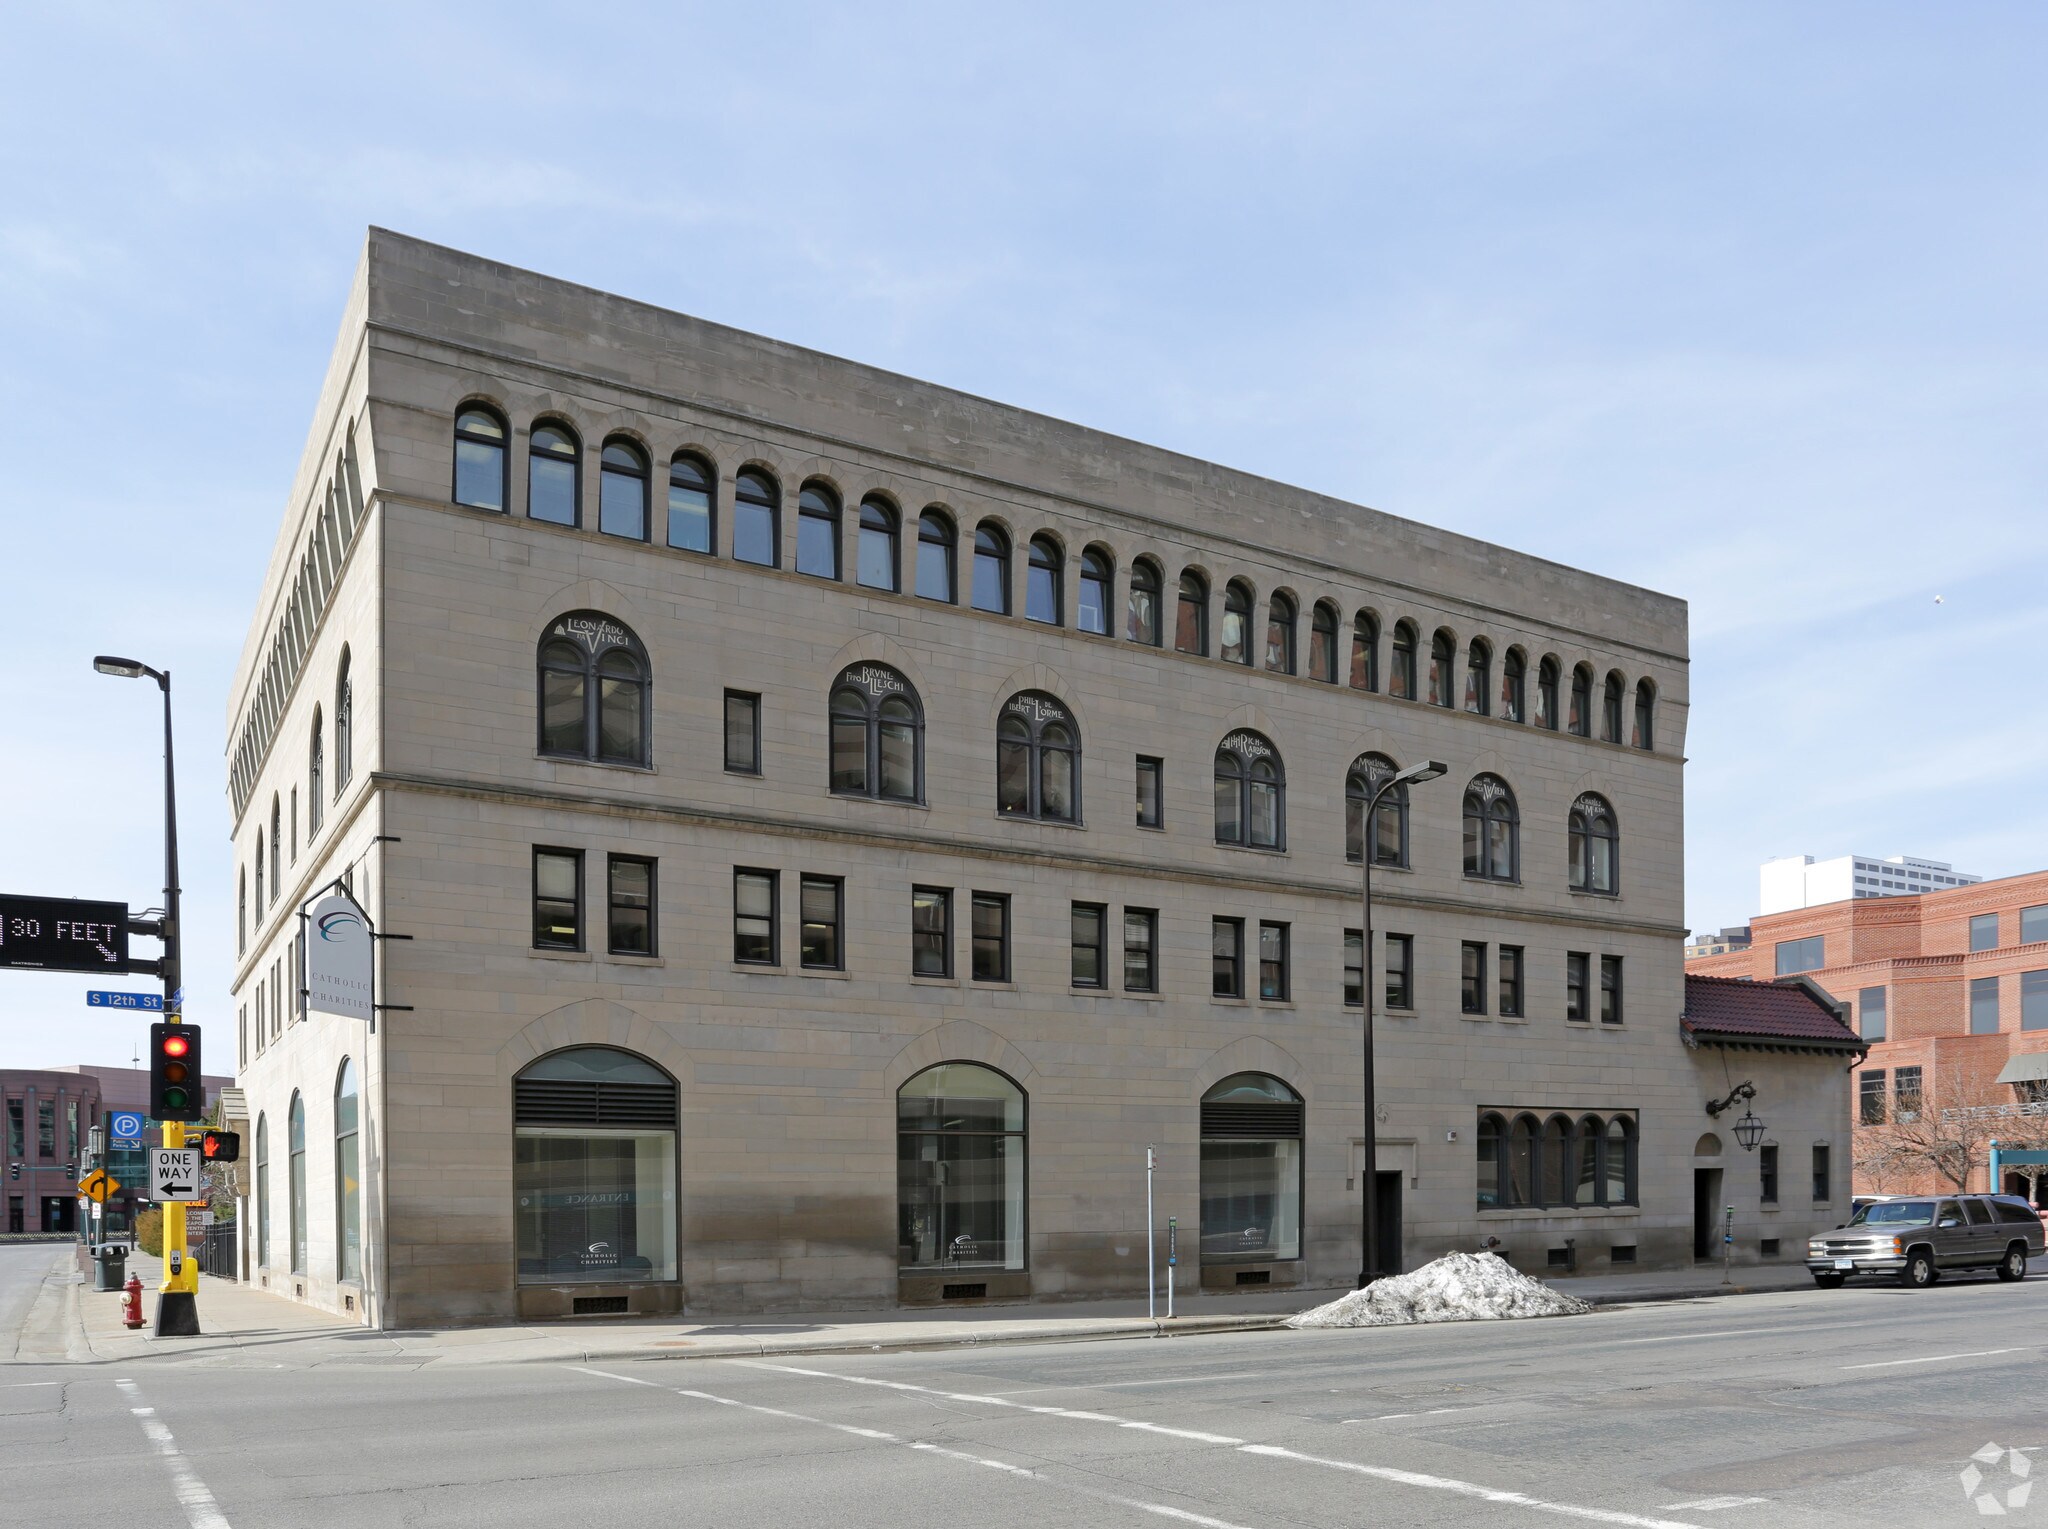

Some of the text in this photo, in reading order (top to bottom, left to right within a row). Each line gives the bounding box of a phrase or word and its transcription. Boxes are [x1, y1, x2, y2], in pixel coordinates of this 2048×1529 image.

[11, 918, 117, 942] 30 FEET
[312, 972, 369, 991] CATHOLIC
[92, 993, 158, 1008] S 12th St
[312, 991, 370, 1010] CHARITIES
[122, 1119, 134, 1132] P
[160, 1153, 191, 1165] ONE
[158, 1167, 192, 1179] WAY
